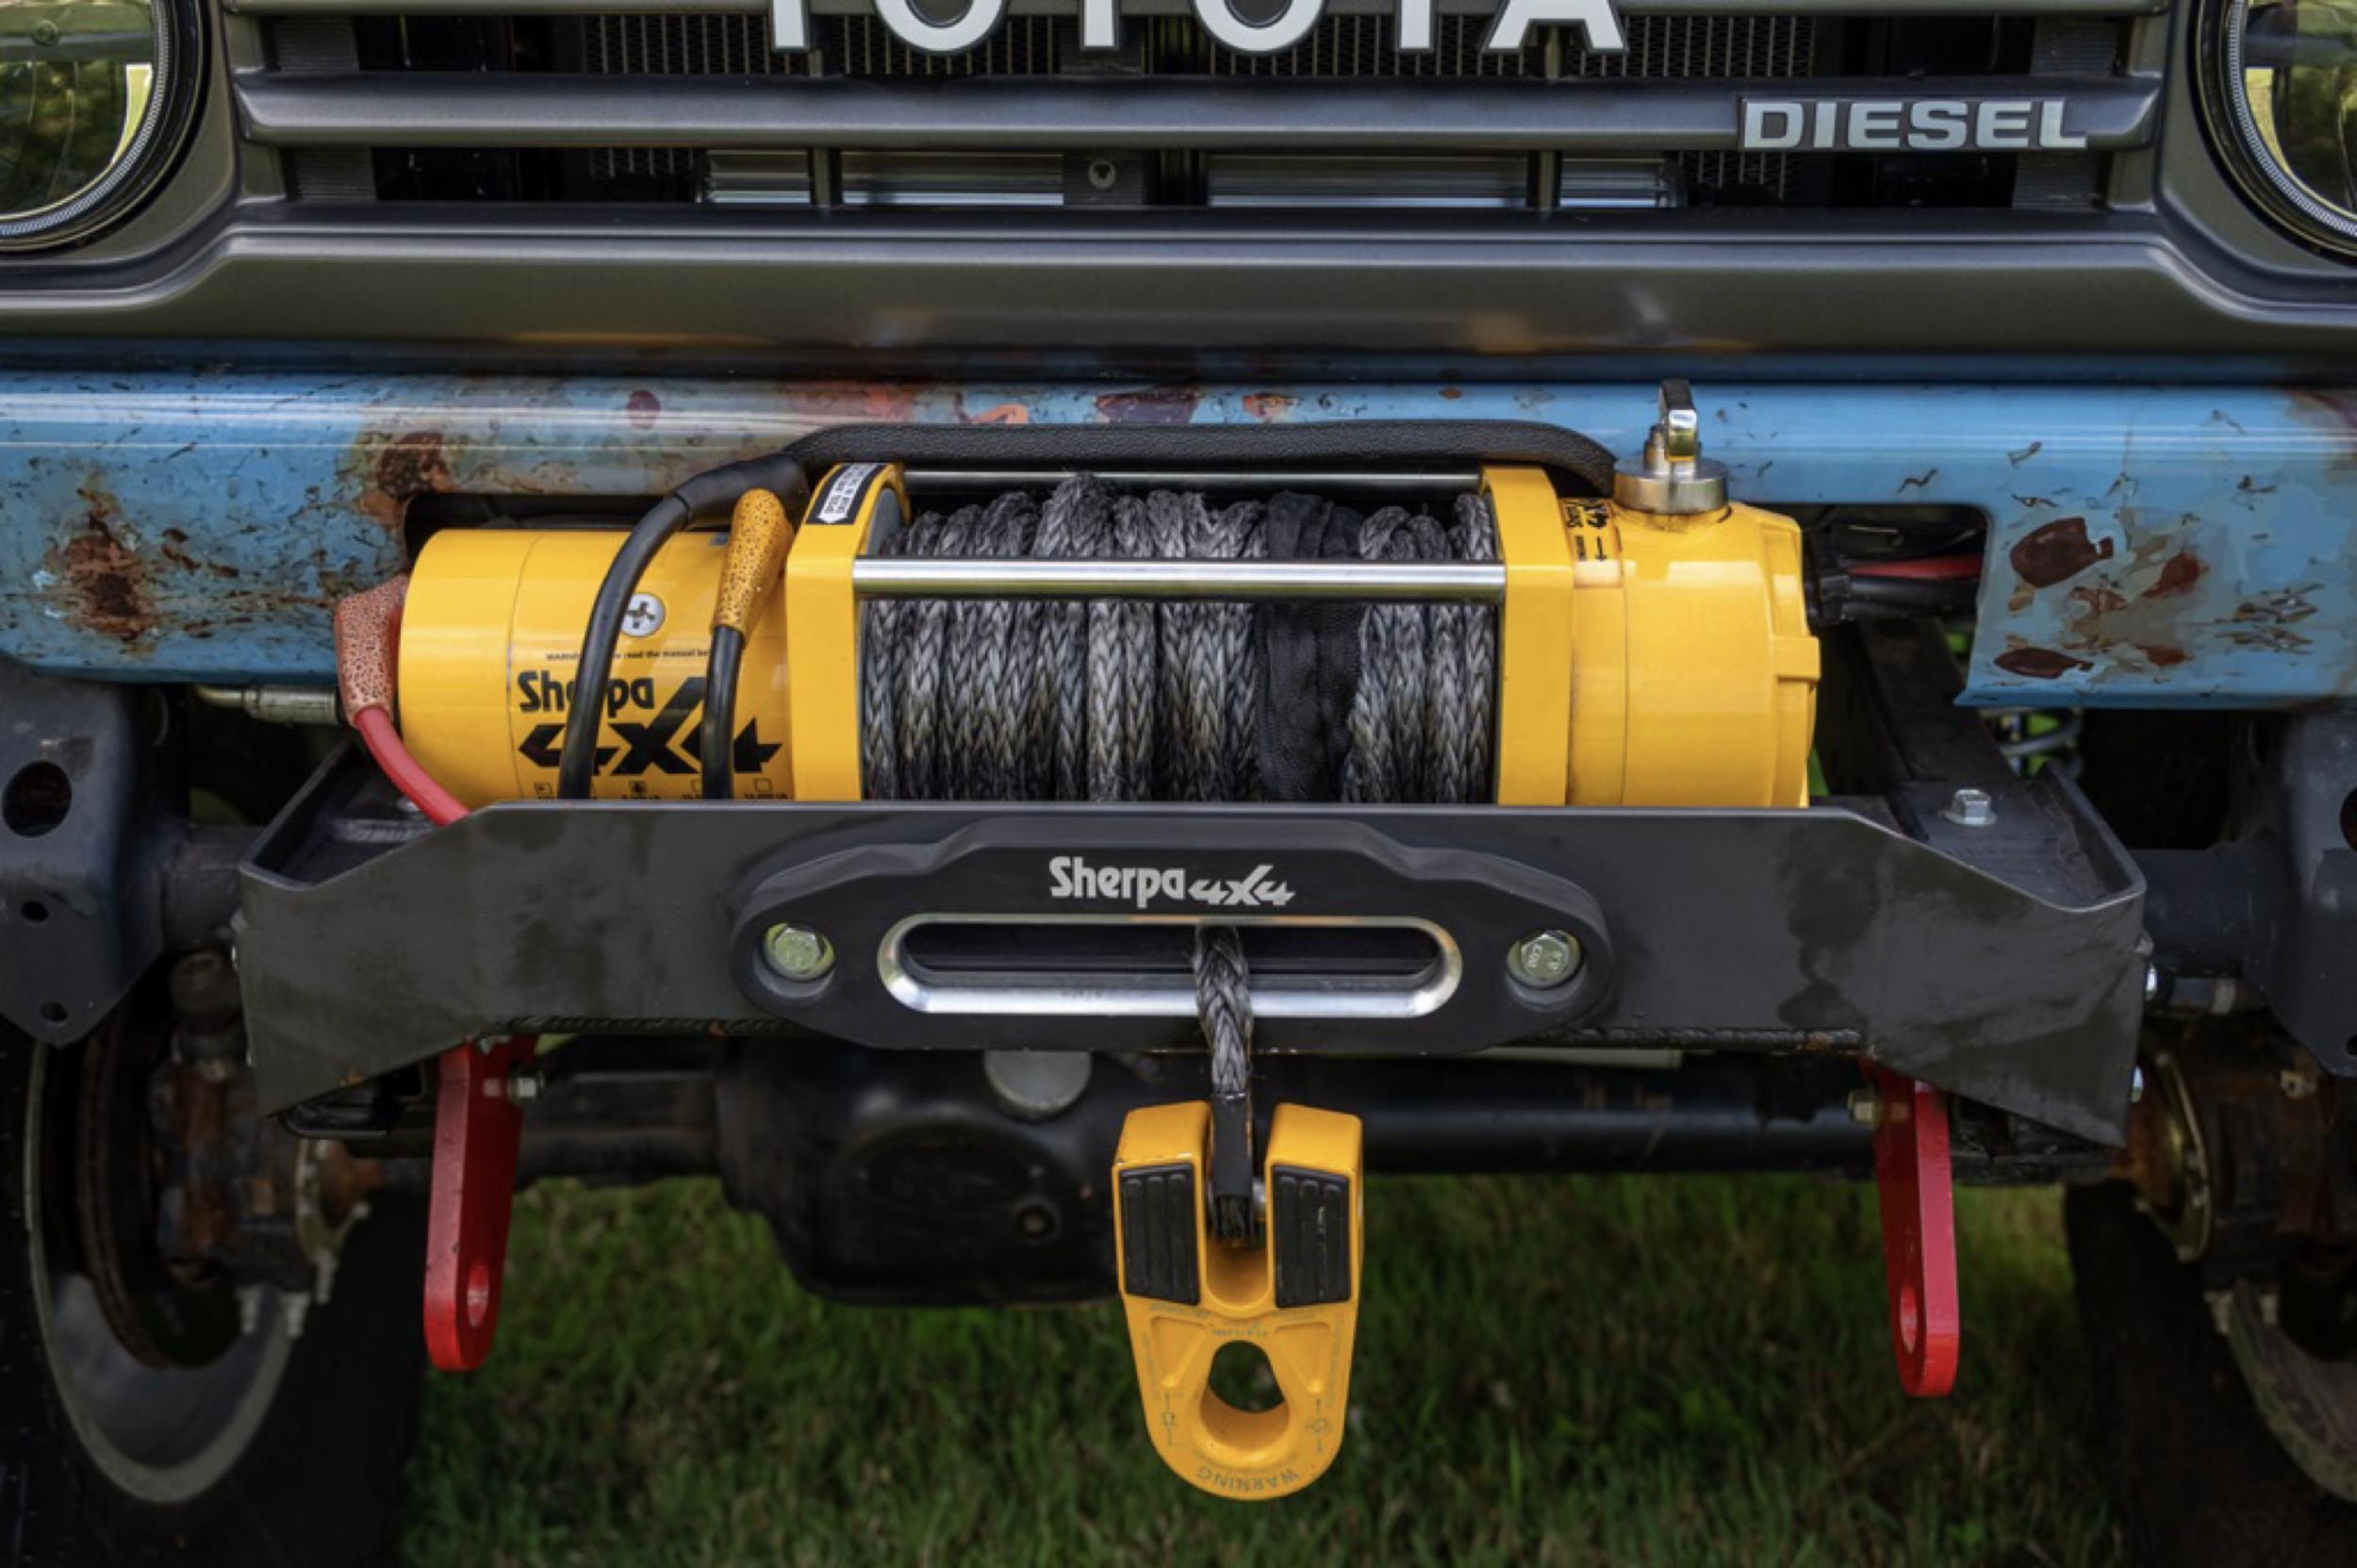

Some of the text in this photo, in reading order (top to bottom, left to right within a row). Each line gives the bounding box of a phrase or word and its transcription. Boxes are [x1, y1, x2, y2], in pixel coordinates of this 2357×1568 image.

[1743, 100, 2087, 149] DIESEL
[518, 670, 654, 718] Shpa
[1195, 1464, 1300, 1492] WARNING
